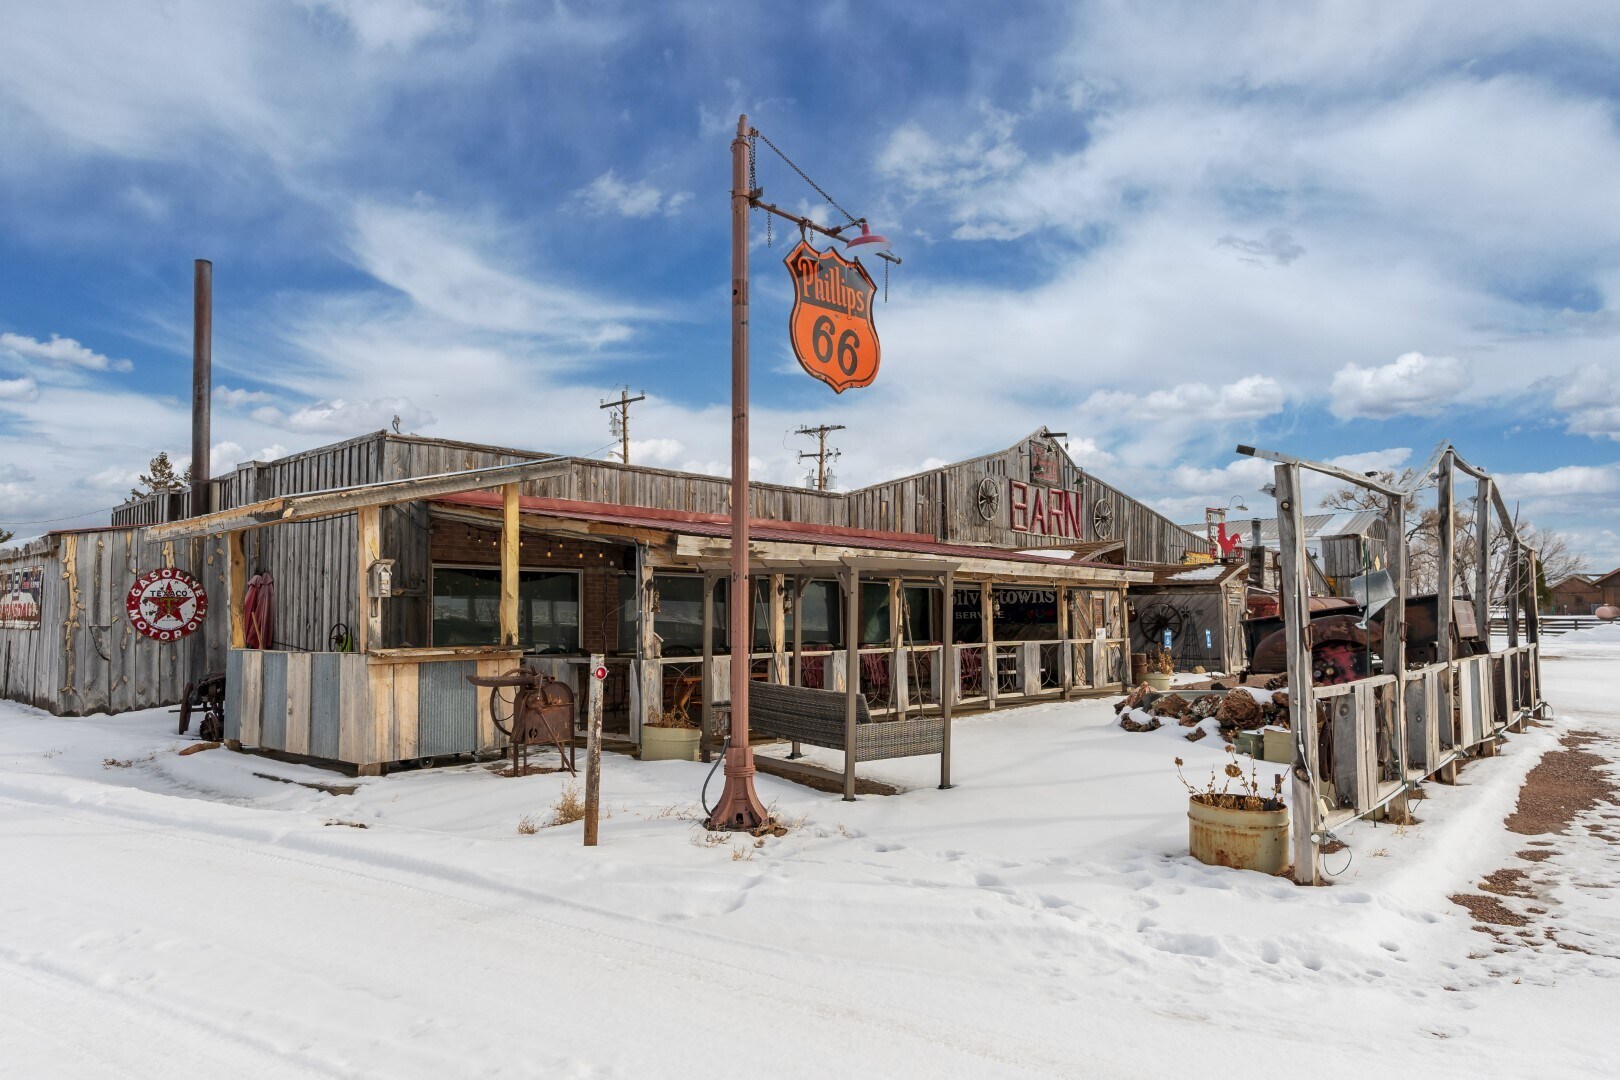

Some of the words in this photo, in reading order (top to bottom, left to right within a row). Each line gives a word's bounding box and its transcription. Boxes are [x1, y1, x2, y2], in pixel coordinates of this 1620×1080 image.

[797, 256, 865, 319] Phillips
[812, 315, 860, 377] 66
[1010, 481, 1083, 539] BARN
[131, 569, 204, 597] GASOLINE
[953, 589, 1055, 606] ilvrtowns
[129, 609, 182, 640] MOTOR
[187, 608, 206, 631] OIL
[955, 611, 1005, 620] SERVE
